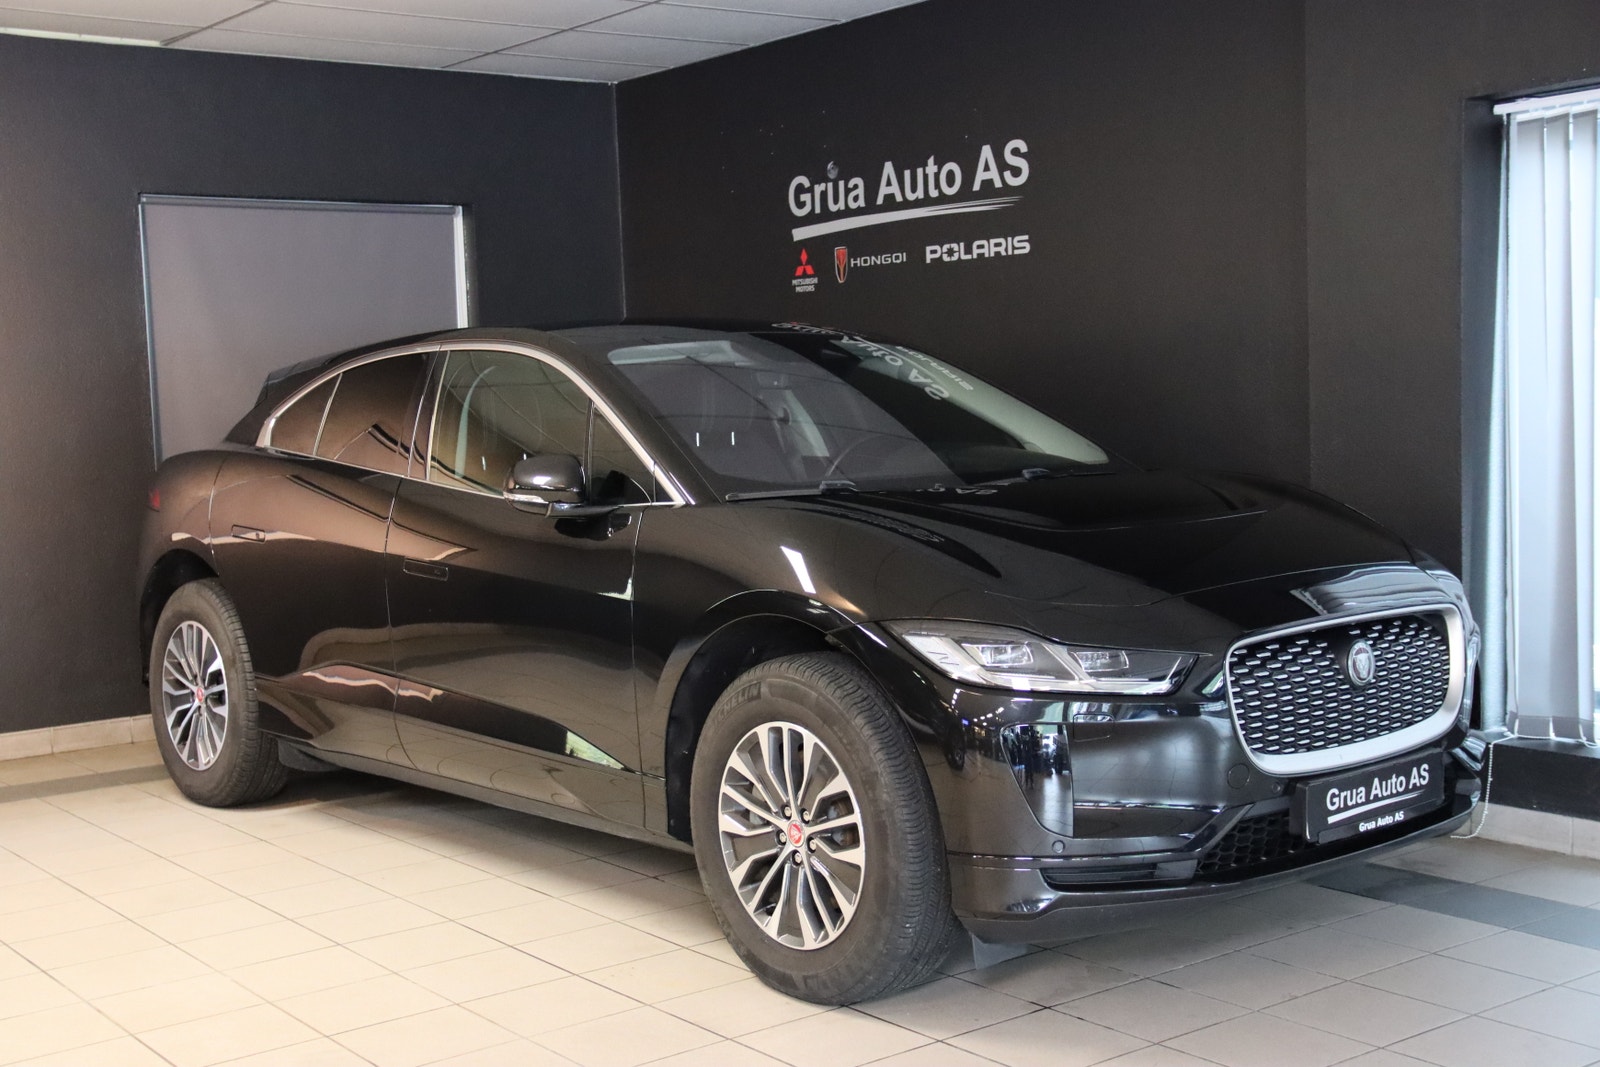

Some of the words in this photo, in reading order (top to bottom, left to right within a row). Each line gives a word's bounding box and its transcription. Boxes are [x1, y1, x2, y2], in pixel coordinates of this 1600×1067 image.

[788, 175, 866, 217] Grua
[876, 154, 962, 205] Auto
[972, 138, 1030, 191] AS
[850, 252, 907, 268] HONGQI
[925, 234, 1031, 264] POLARIS
[796, 285, 815, 293] MOTORS
[1326, 787, 1366, 811] Grua
[1370, 774, 1406, 800] Auto
[1409, 763, 1430, 789] AS
[1359, 821, 1376, 832] Grua
[1377, 815, 1393, 827] Auto
[1394, 811, 1405, 821] AS
